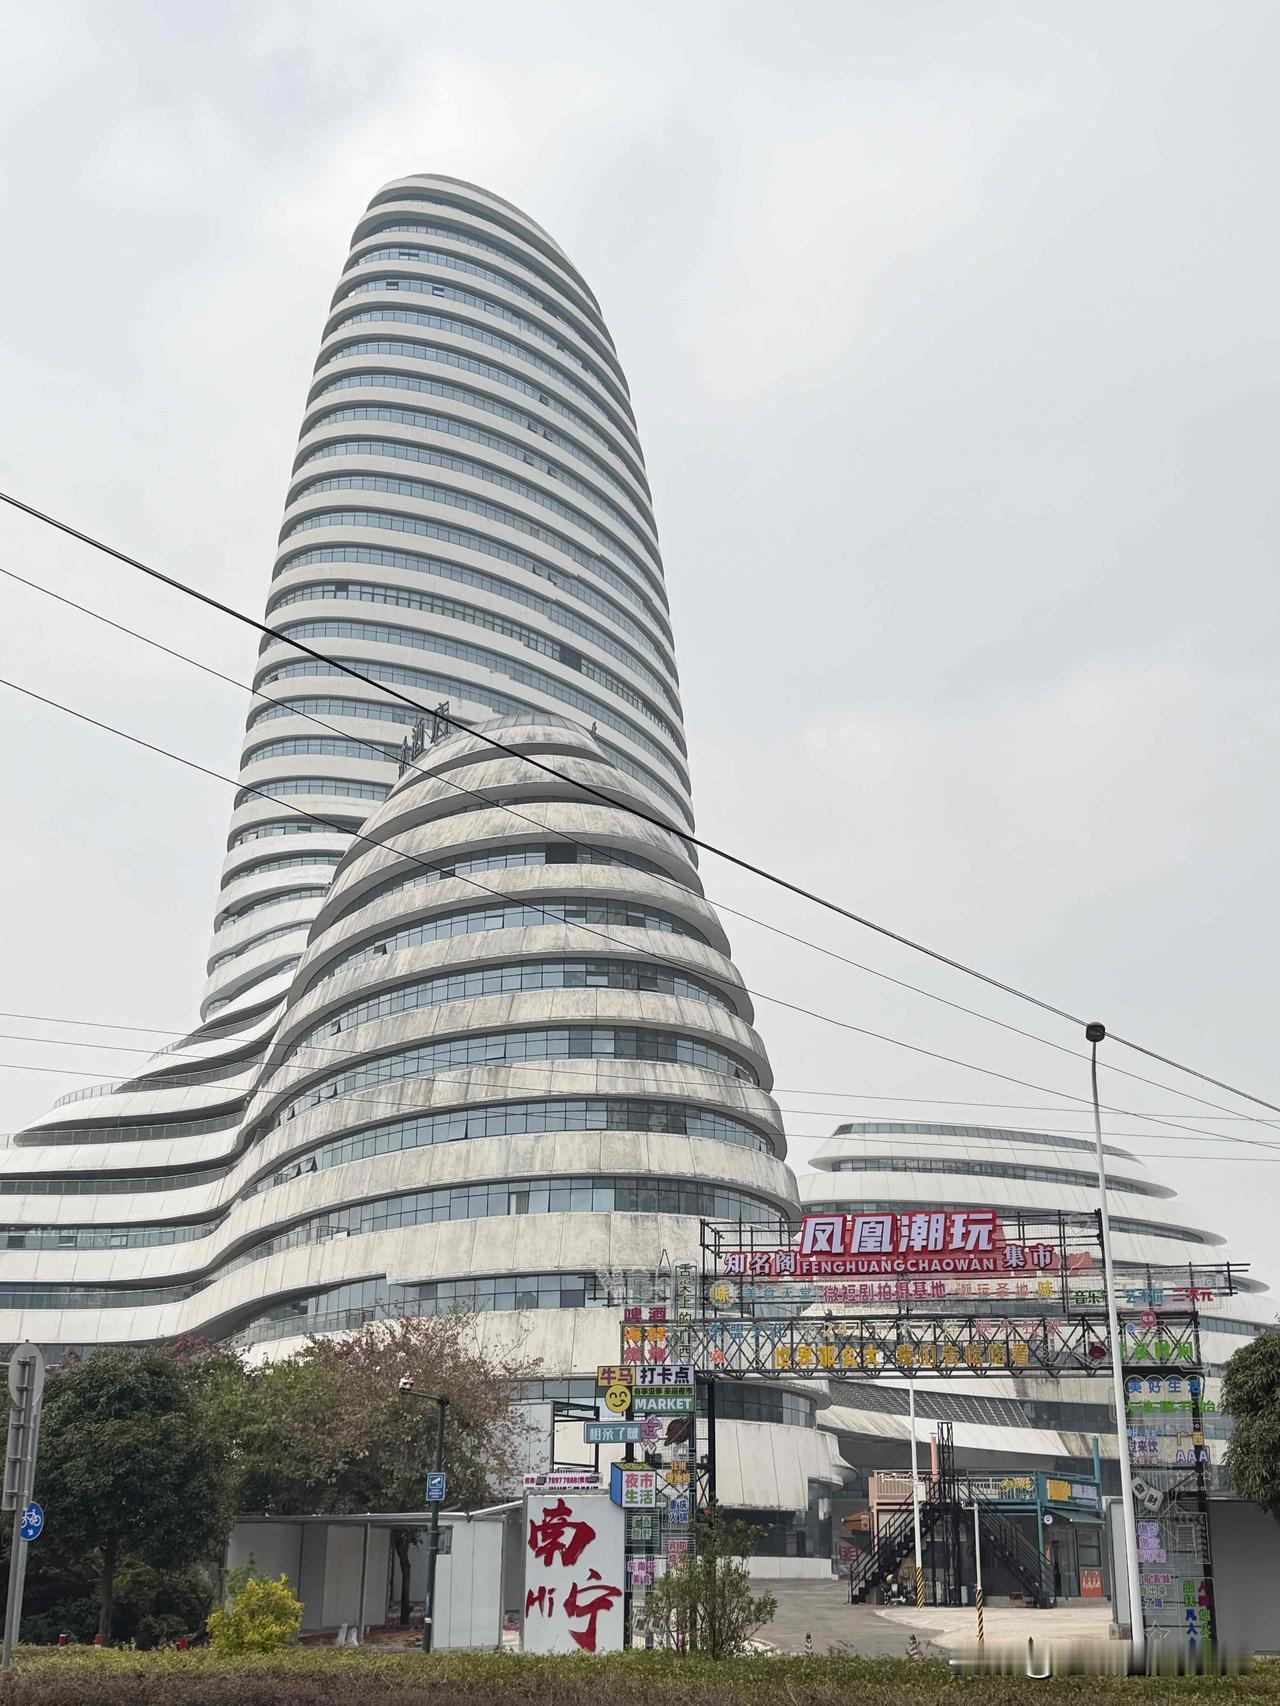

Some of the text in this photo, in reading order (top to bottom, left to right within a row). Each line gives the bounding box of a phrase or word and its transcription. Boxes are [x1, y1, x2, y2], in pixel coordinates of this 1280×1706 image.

[802, 1213, 995, 1254] 凤凰潮玩
[725, 1250, 798, 1275] 知名阁
[1002, 1244, 1053, 1269] 集市
[802, 1258, 994, 1274] FENGHUANGCHAOWAN
[744, 1286, 812, 1301] 美食天堂
[823, 1281, 947, 1302] 微短剧拍摄基地
[958, 1281, 1030, 1299] 潮玩圣地
[624, 1306, 667, 1322] 啤酒
[677, 1262, 693, 1359] 舌尖上的广西
[774, 1345, 880, 1369] 世界那么大
[600, 1367, 635, 1385] 牛马
[640, 1367, 690, 1384] 打卡点
[1128, 1379, 1202, 1393] 美好生活
[634, 1398, 692, 1410] MARKET
[625, 1472, 653, 1488] 夜市
[625, 1489, 653, 1505] 生活
[525, 1586, 556, 1618] Hi
